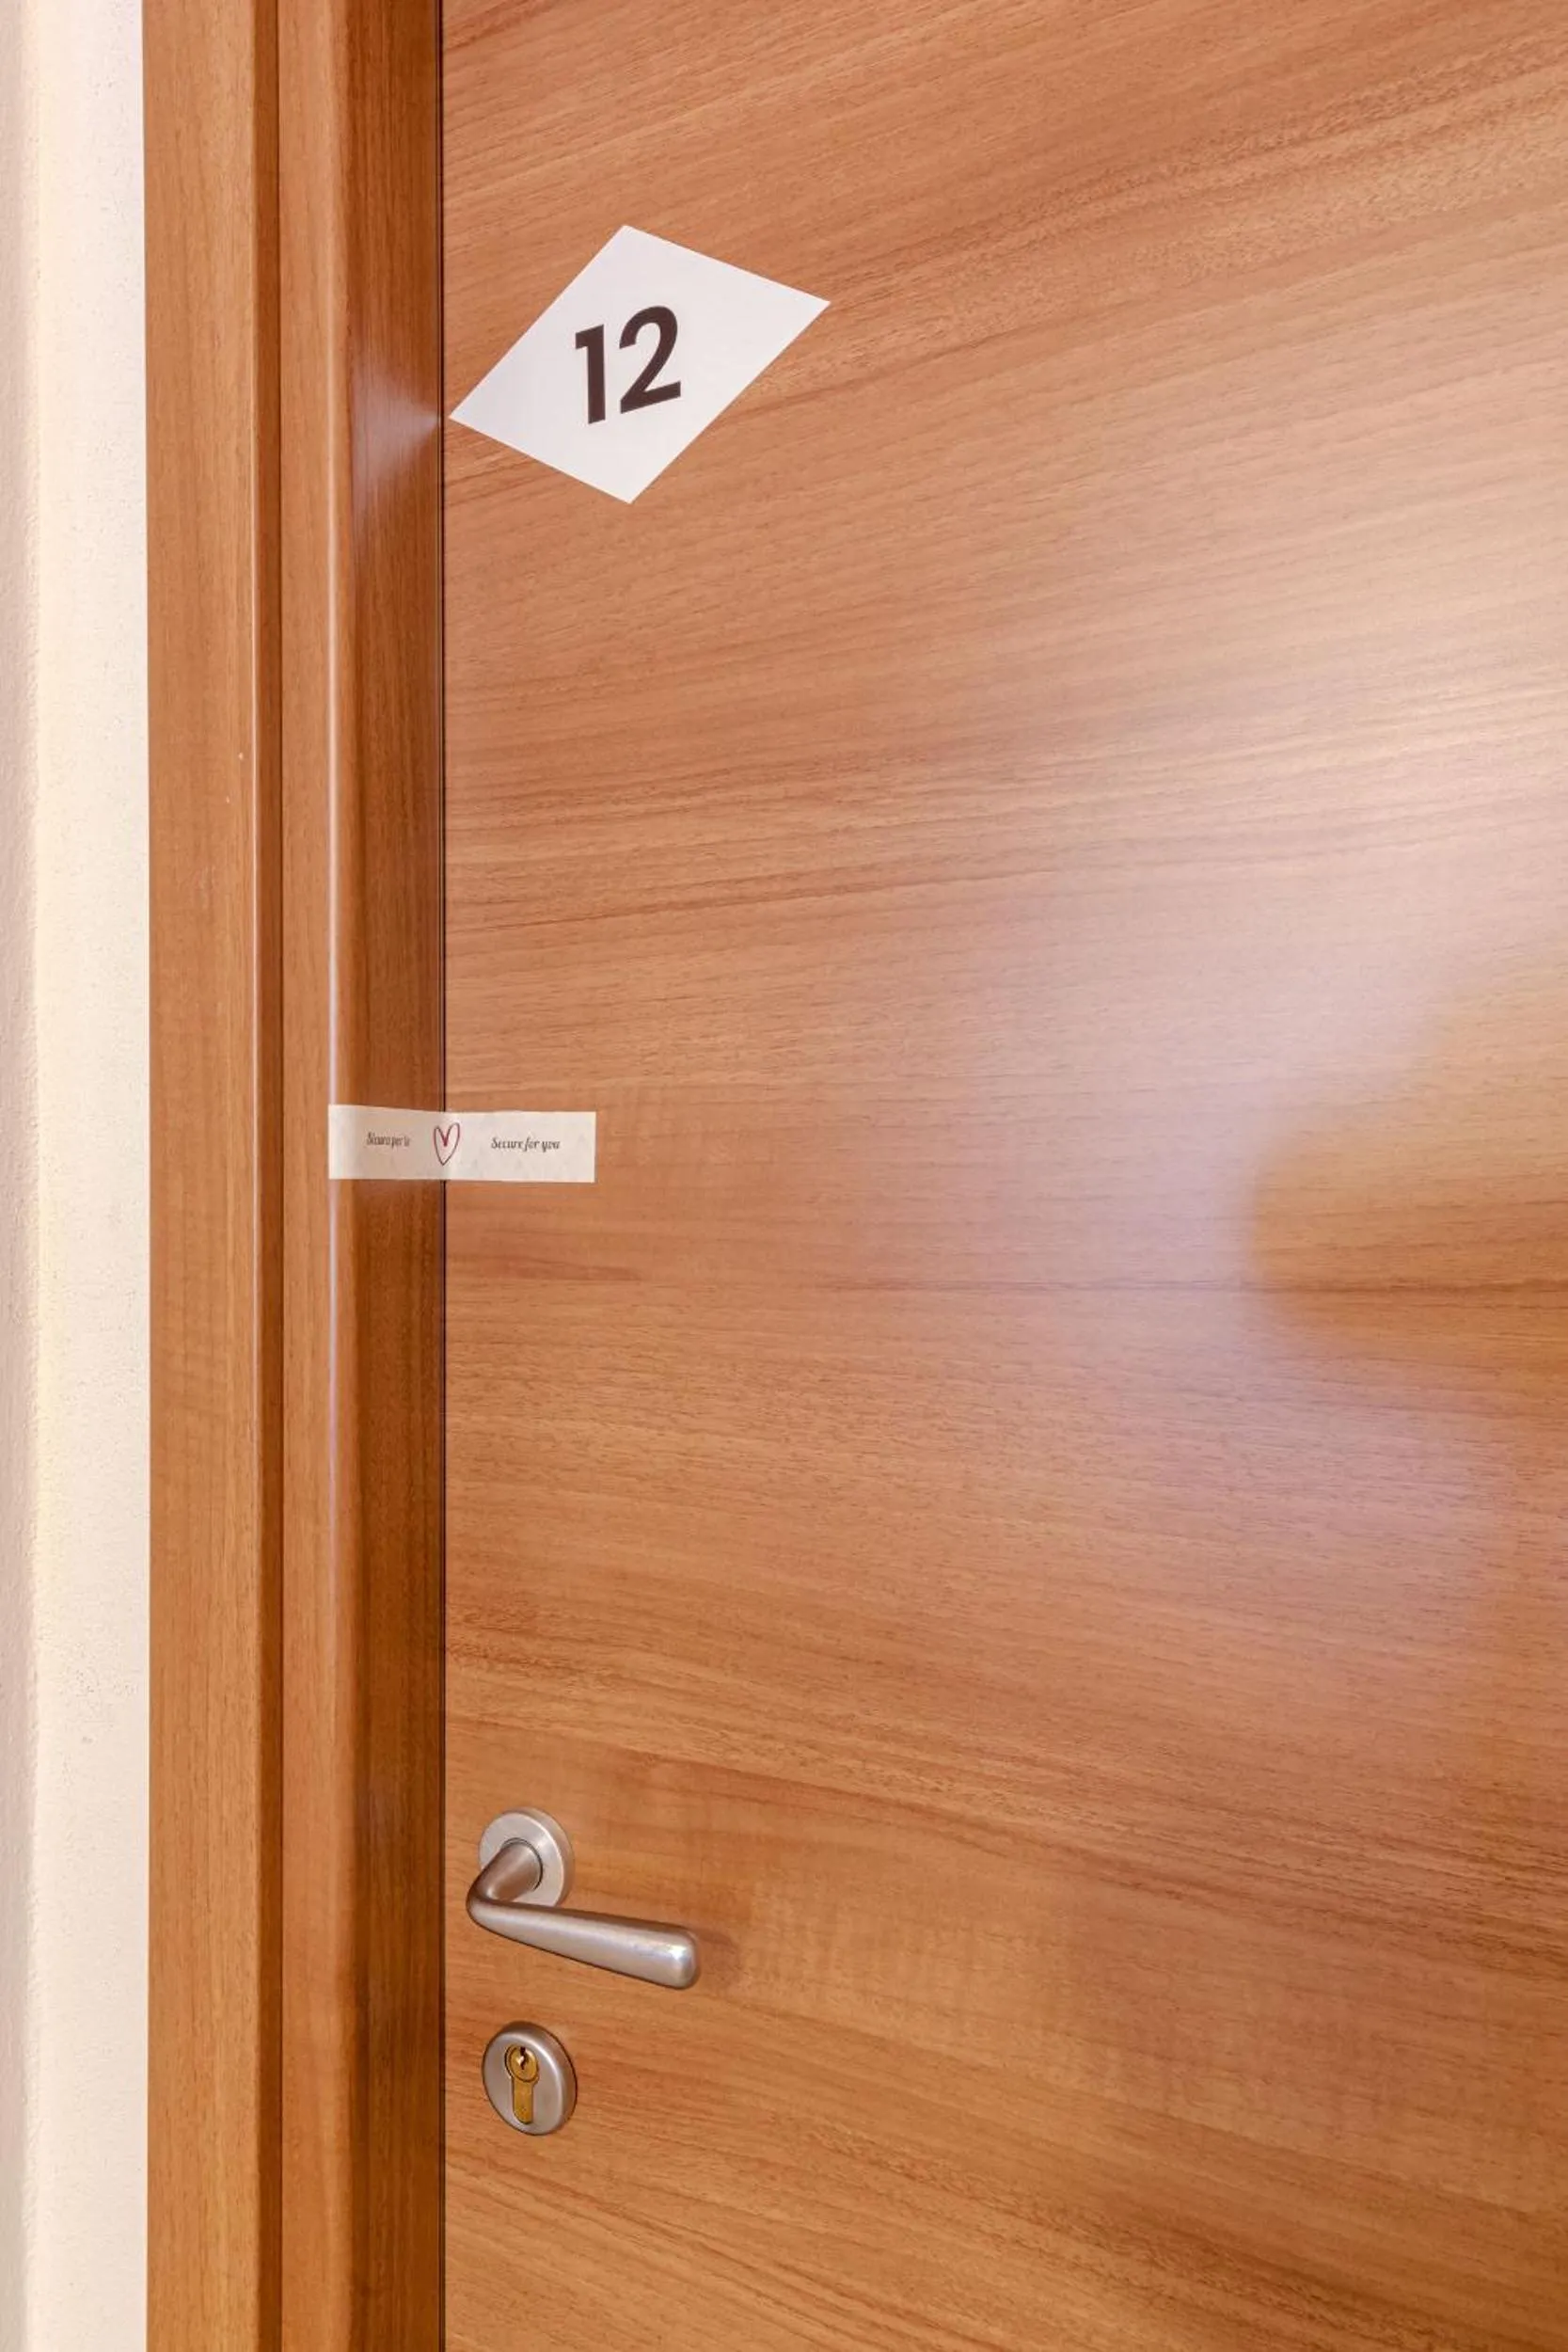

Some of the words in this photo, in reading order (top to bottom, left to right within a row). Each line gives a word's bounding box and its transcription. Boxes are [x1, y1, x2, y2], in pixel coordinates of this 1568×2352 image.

[575, 305, 682, 425] 12
[491, 1136, 523, 1149] Secure
[522, 1136, 540, 1152] for
[542, 1140, 561, 1152] you
